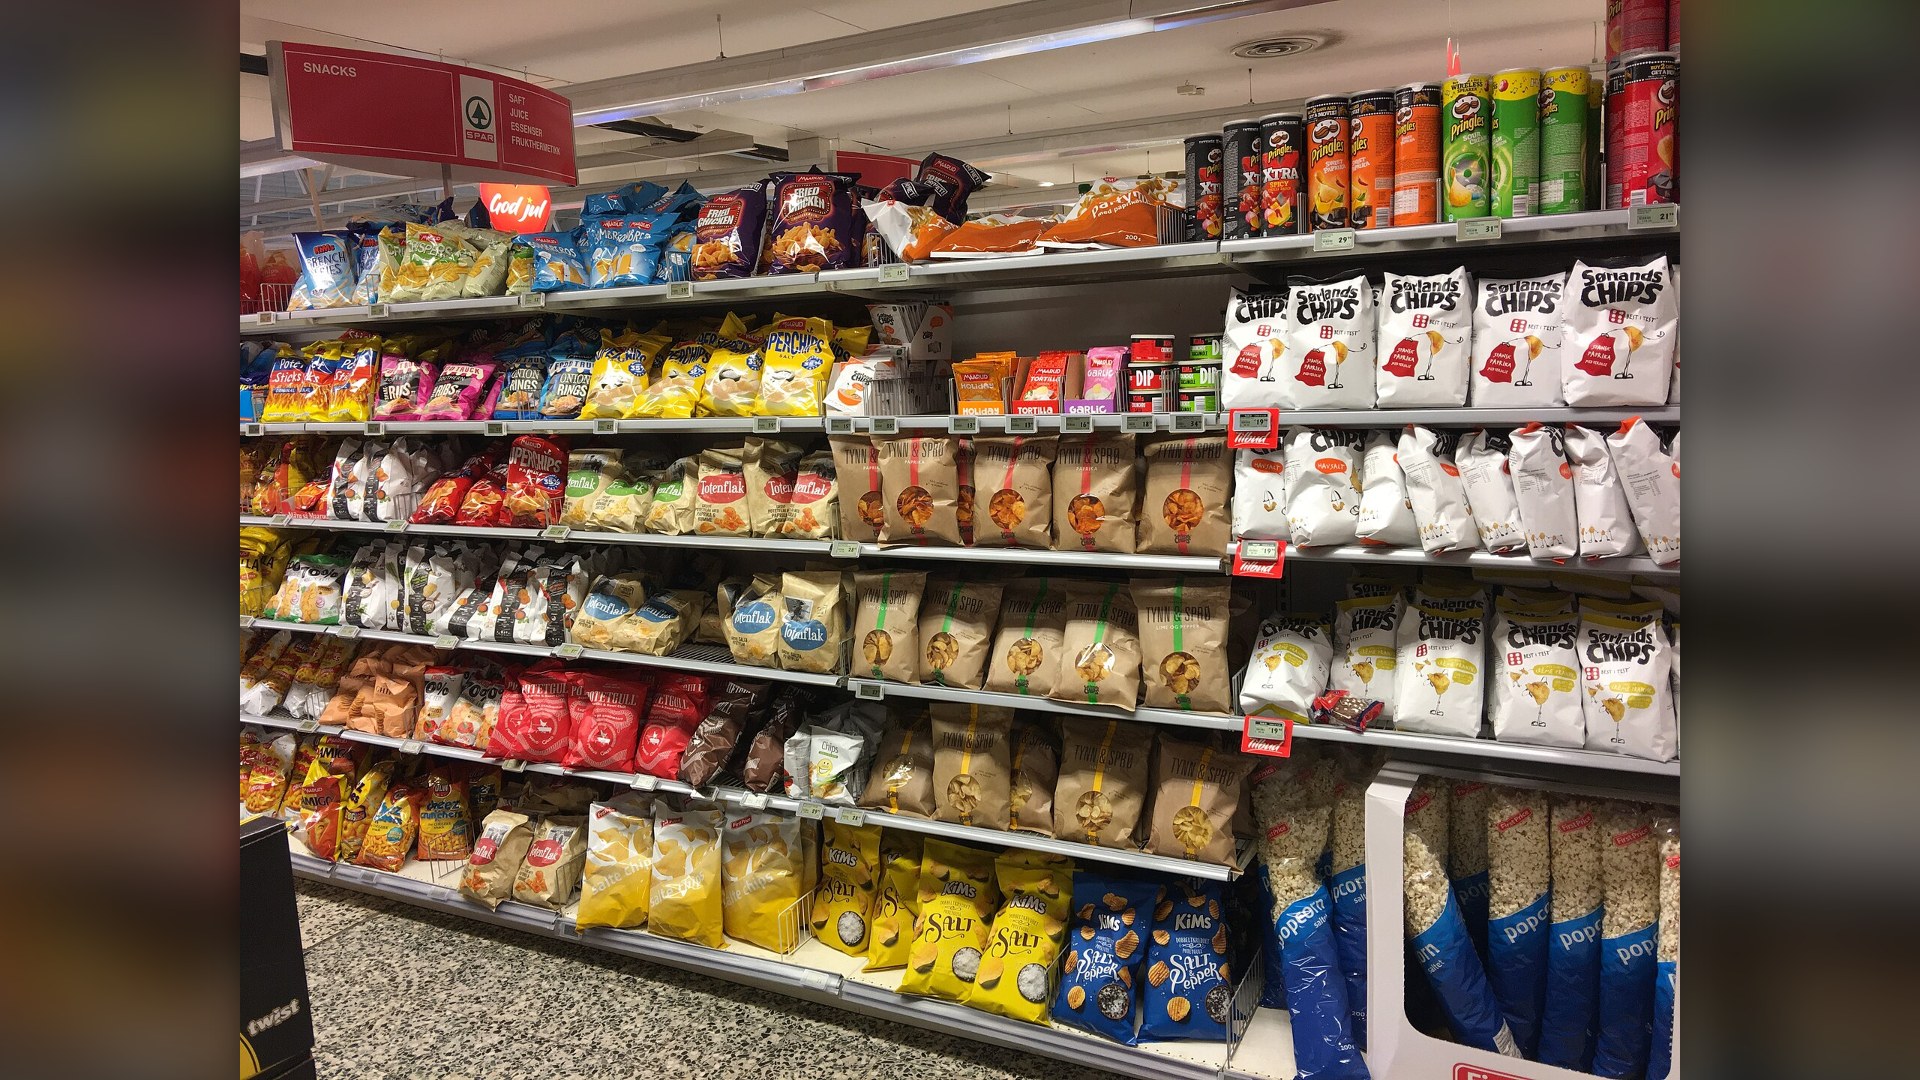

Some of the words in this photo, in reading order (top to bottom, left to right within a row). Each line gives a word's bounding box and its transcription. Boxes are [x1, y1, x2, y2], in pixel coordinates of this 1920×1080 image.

[303, 62, 357, 77] SNACKS
[509, 94, 526, 106] SAFT
[510, 108, 529, 120] JUICE
[466, 131, 494, 142] SPAR
[511, 122, 543, 137] ESSENSER
[1450, 114, 1484, 142] Pringles
[1268, 144, 1292, 162] Pringles
[1311, 140, 1344, 167] Pringles
[935, 160, 957, 172] MAARUD
[1263, 167, 1299, 183] XTRA
[794, 187, 819, 197] FRIED
[490, 194, 518, 213] God
[519, 199, 547, 221] jul
[707, 208, 730, 218] FRIED
[789, 199, 825, 212] CHICKEN
[1098, 209, 1112, 217] med
[697, 215, 734, 228] CHICKEN
[1581, 269, 1663, 286] Sørlands
[1296, 285, 1359, 304] Sørlands
[1391, 278, 1459, 295] Sørlands
[1485, 279, 1561, 298] Sørlands
[1581, 281, 1664, 308] CHIPS
[1390, 291, 1461, 314] CHIPS
[1485, 291, 1561, 317] CHIPS
[1296, 298, 1360, 325] CHIPS
[1092, 359, 1112, 367] MAARUD
[1489, 359, 1512, 368] PAPRIKA
[1587, 351, 1611, 360] PAPRIKA
[272, 371, 301, 382] Sticks
[512, 369, 540, 379] ONION
[560, 374, 590, 385] ONION
[1088, 369, 1113, 377] GARLIC
[1136, 370, 1154, 386] DIP
[436, 384, 458, 397] RIBS
[510, 380, 538, 391] RINGS
[558, 385, 587, 396] RINGS
[1017, 406, 1053, 414] TORTILLA
[1069, 405, 1107, 414] GARLIC
[1234, 432, 1270, 444] Tilbud
[845, 449, 867, 464] TYNN
[888, 443, 909, 458] TYNN
[911, 443, 919, 457] &
[987, 446, 1009, 463] TYNN
[1058, 449, 1082, 465] TYNN
[1084, 448, 1091, 464] &
[1094, 448, 1120, 465] SPRØ
[1158, 444, 1182, 458] TYNN
[1195, 443, 1222, 459] SPRØ
[1254, 462, 1280, 471] HAVSALT
[700, 480, 745, 494] Totenflak
[1240, 562, 1276, 573] Tilbud
[1008, 600, 1030, 613] TYNN
[1075, 604, 1098, 618] TYNN
[1101, 605, 1108, 619] &
[1146, 606, 1170, 623] TYNN
[1174, 606, 1181, 622] &
[1185, 606, 1211, 622] SPRØ
[784, 623, 824, 642] Totenflak
[1419, 620, 1481, 644] CHIPS
[1508, 628, 1576, 650] CHIPS
[1588, 628, 1653, 645] Sørlands
[1586, 642, 1656, 665] CHIPS
[822, 741, 839, 754] Chips
[943, 732, 964, 746] TYNN
[966, 733, 973, 749] &
[1248, 739, 1282, 752] Tilbud
[1075, 745, 1095, 761] TYNN
[1100, 746, 1106, 763] &
[1108, 751, 1133, 769] SPRØ
[1171, 758, 1196, 778] TYNN
[1198, 764, 1205, 779] &
[1208, 766, 1235, 786] SPRØ
[1500, 819, 1514, 831] First
[1513, 810, 1531, 824] Price
[1560, 821, 1575, 831] First
[1575, 815, 1593, 827] Price
[1615, 834, 1630, 845] First
[1629, 827, 1649, 840] Price
[828, 848, 857, 867] KiMs
[591, 870, 622, 896] salte
[743, 873, 774, 896] chips
[822, 880, 856, 903] SALT
[941, 881, 976, 898] KiMs
[1010, 894, 1047, 915] KiMs
[925, 913, 976, 943] SALT
[1098, 914, 1121, 931] KiMs
[1175, 914, 1212, 931] KiMs
[991, 927, 1043, 958] SALT
[1083, 949, 1114, 968] SALT
[1170, 953, 1211, 971] SALT
[248, 999, 300, 1036] twist
